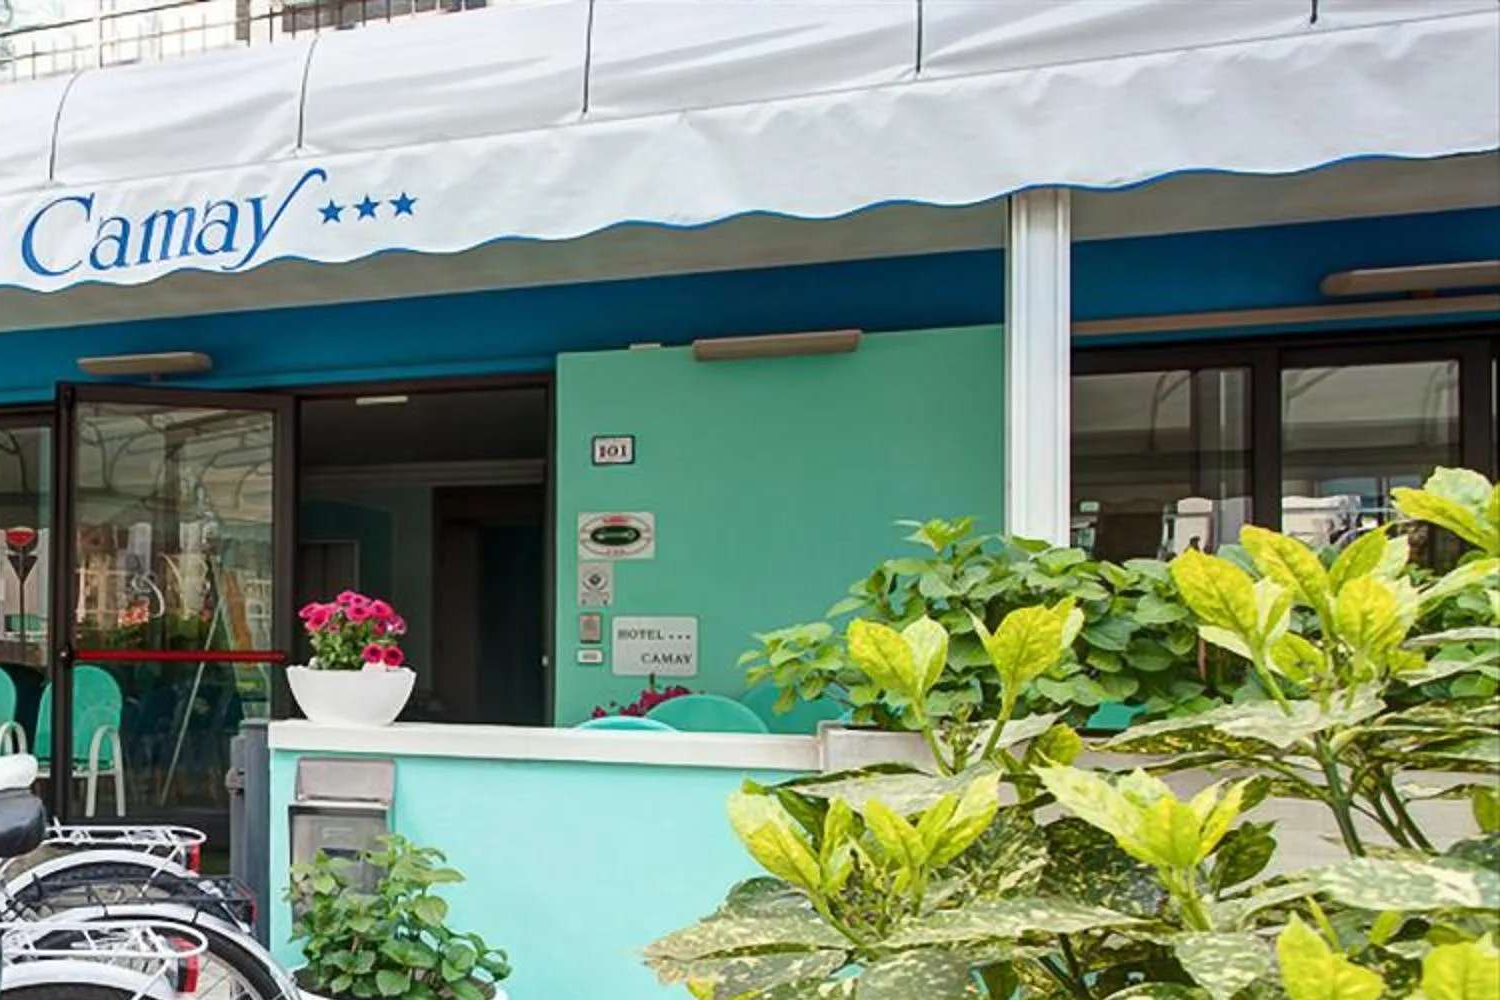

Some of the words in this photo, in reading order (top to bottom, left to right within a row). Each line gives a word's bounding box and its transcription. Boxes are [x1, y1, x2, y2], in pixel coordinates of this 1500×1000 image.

[21, 167, 326, 275] Camay
[598, 444, 629, 459] 101
[616, 628, 665, 642] HOTEL
[640, 652, 693, 666] CAMAY
